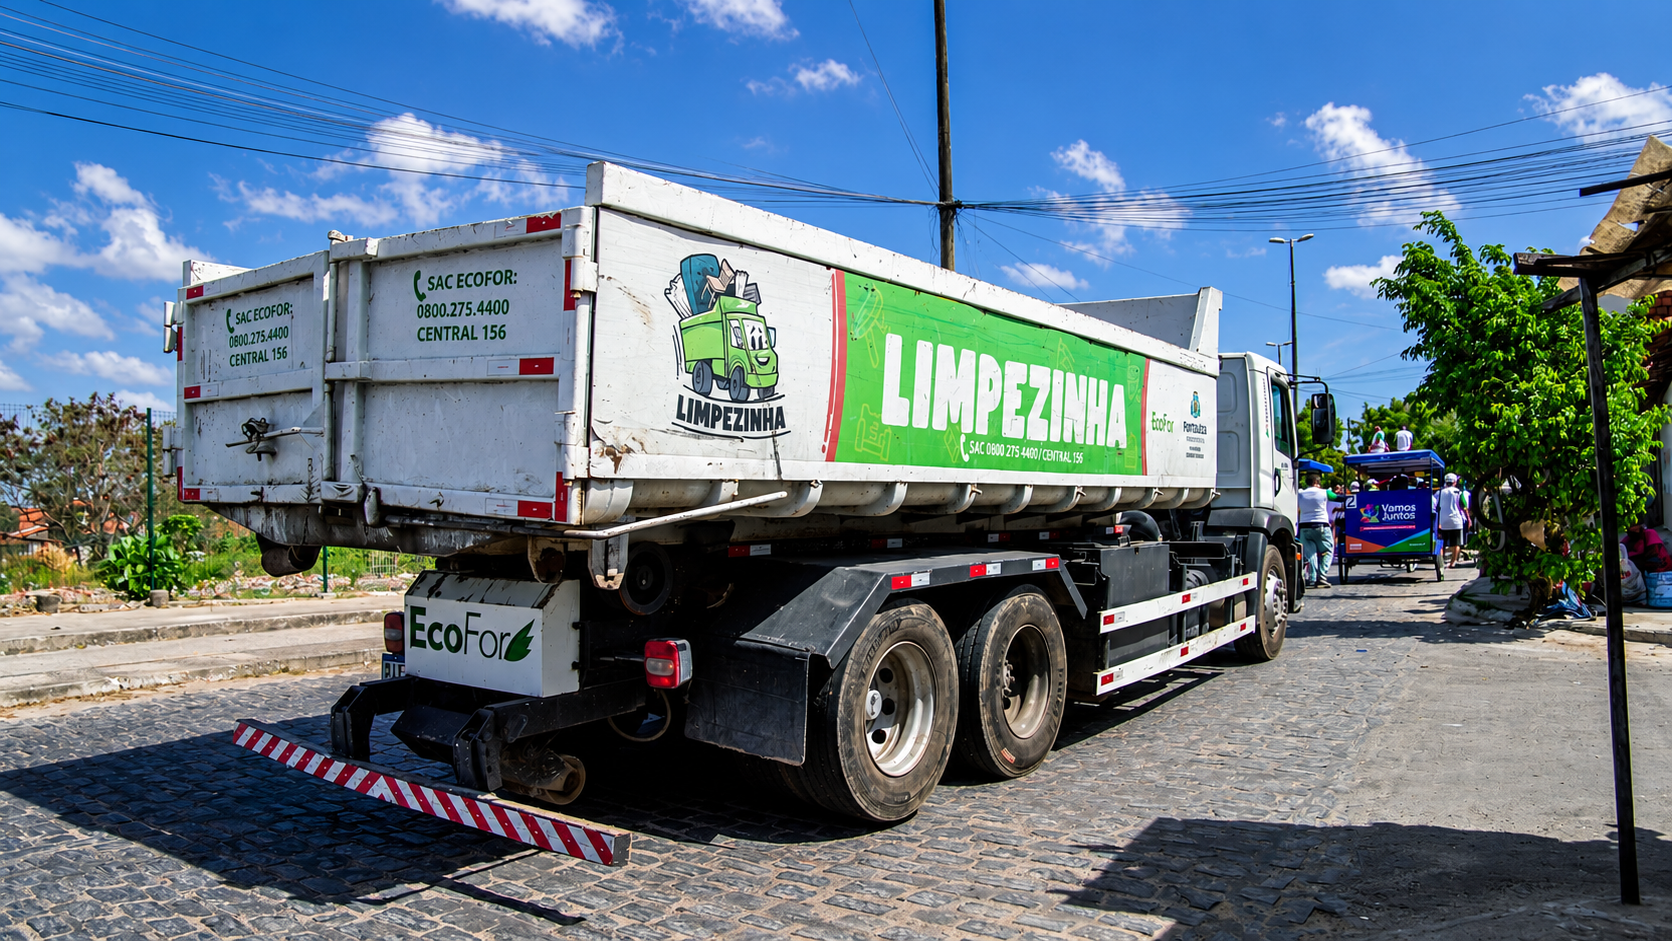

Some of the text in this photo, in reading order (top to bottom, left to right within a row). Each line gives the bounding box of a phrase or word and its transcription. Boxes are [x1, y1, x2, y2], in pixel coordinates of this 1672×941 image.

[428, 269, 518, 291] SAC ECOFOR:
[235, 301, 293, 325] SAC ECOFOR:
[416, 298, 510, 319] 0800.275.4400
[229, 325, 289, 349] 0800.275.4400
[417, 323, 507, 342] CENTRAL 156
[229, 345, 288, 368] CENTRAL 156
[880, 333, 1128, 449] LIMPEZINHA
[675, 393, 787, 432] LIMPEZINHA
[969, 440, 985, 455] SAC
[986, 442, 1005, 457] 0800
[1006, 444, 1020, 458] 275
[1347, 495, 1356, 508] 2
[1381, 503, 1416, 512] Vamos
[1381, 511, 1416, 521] Juntos
[409, 605, 512, 660] EcoFor
